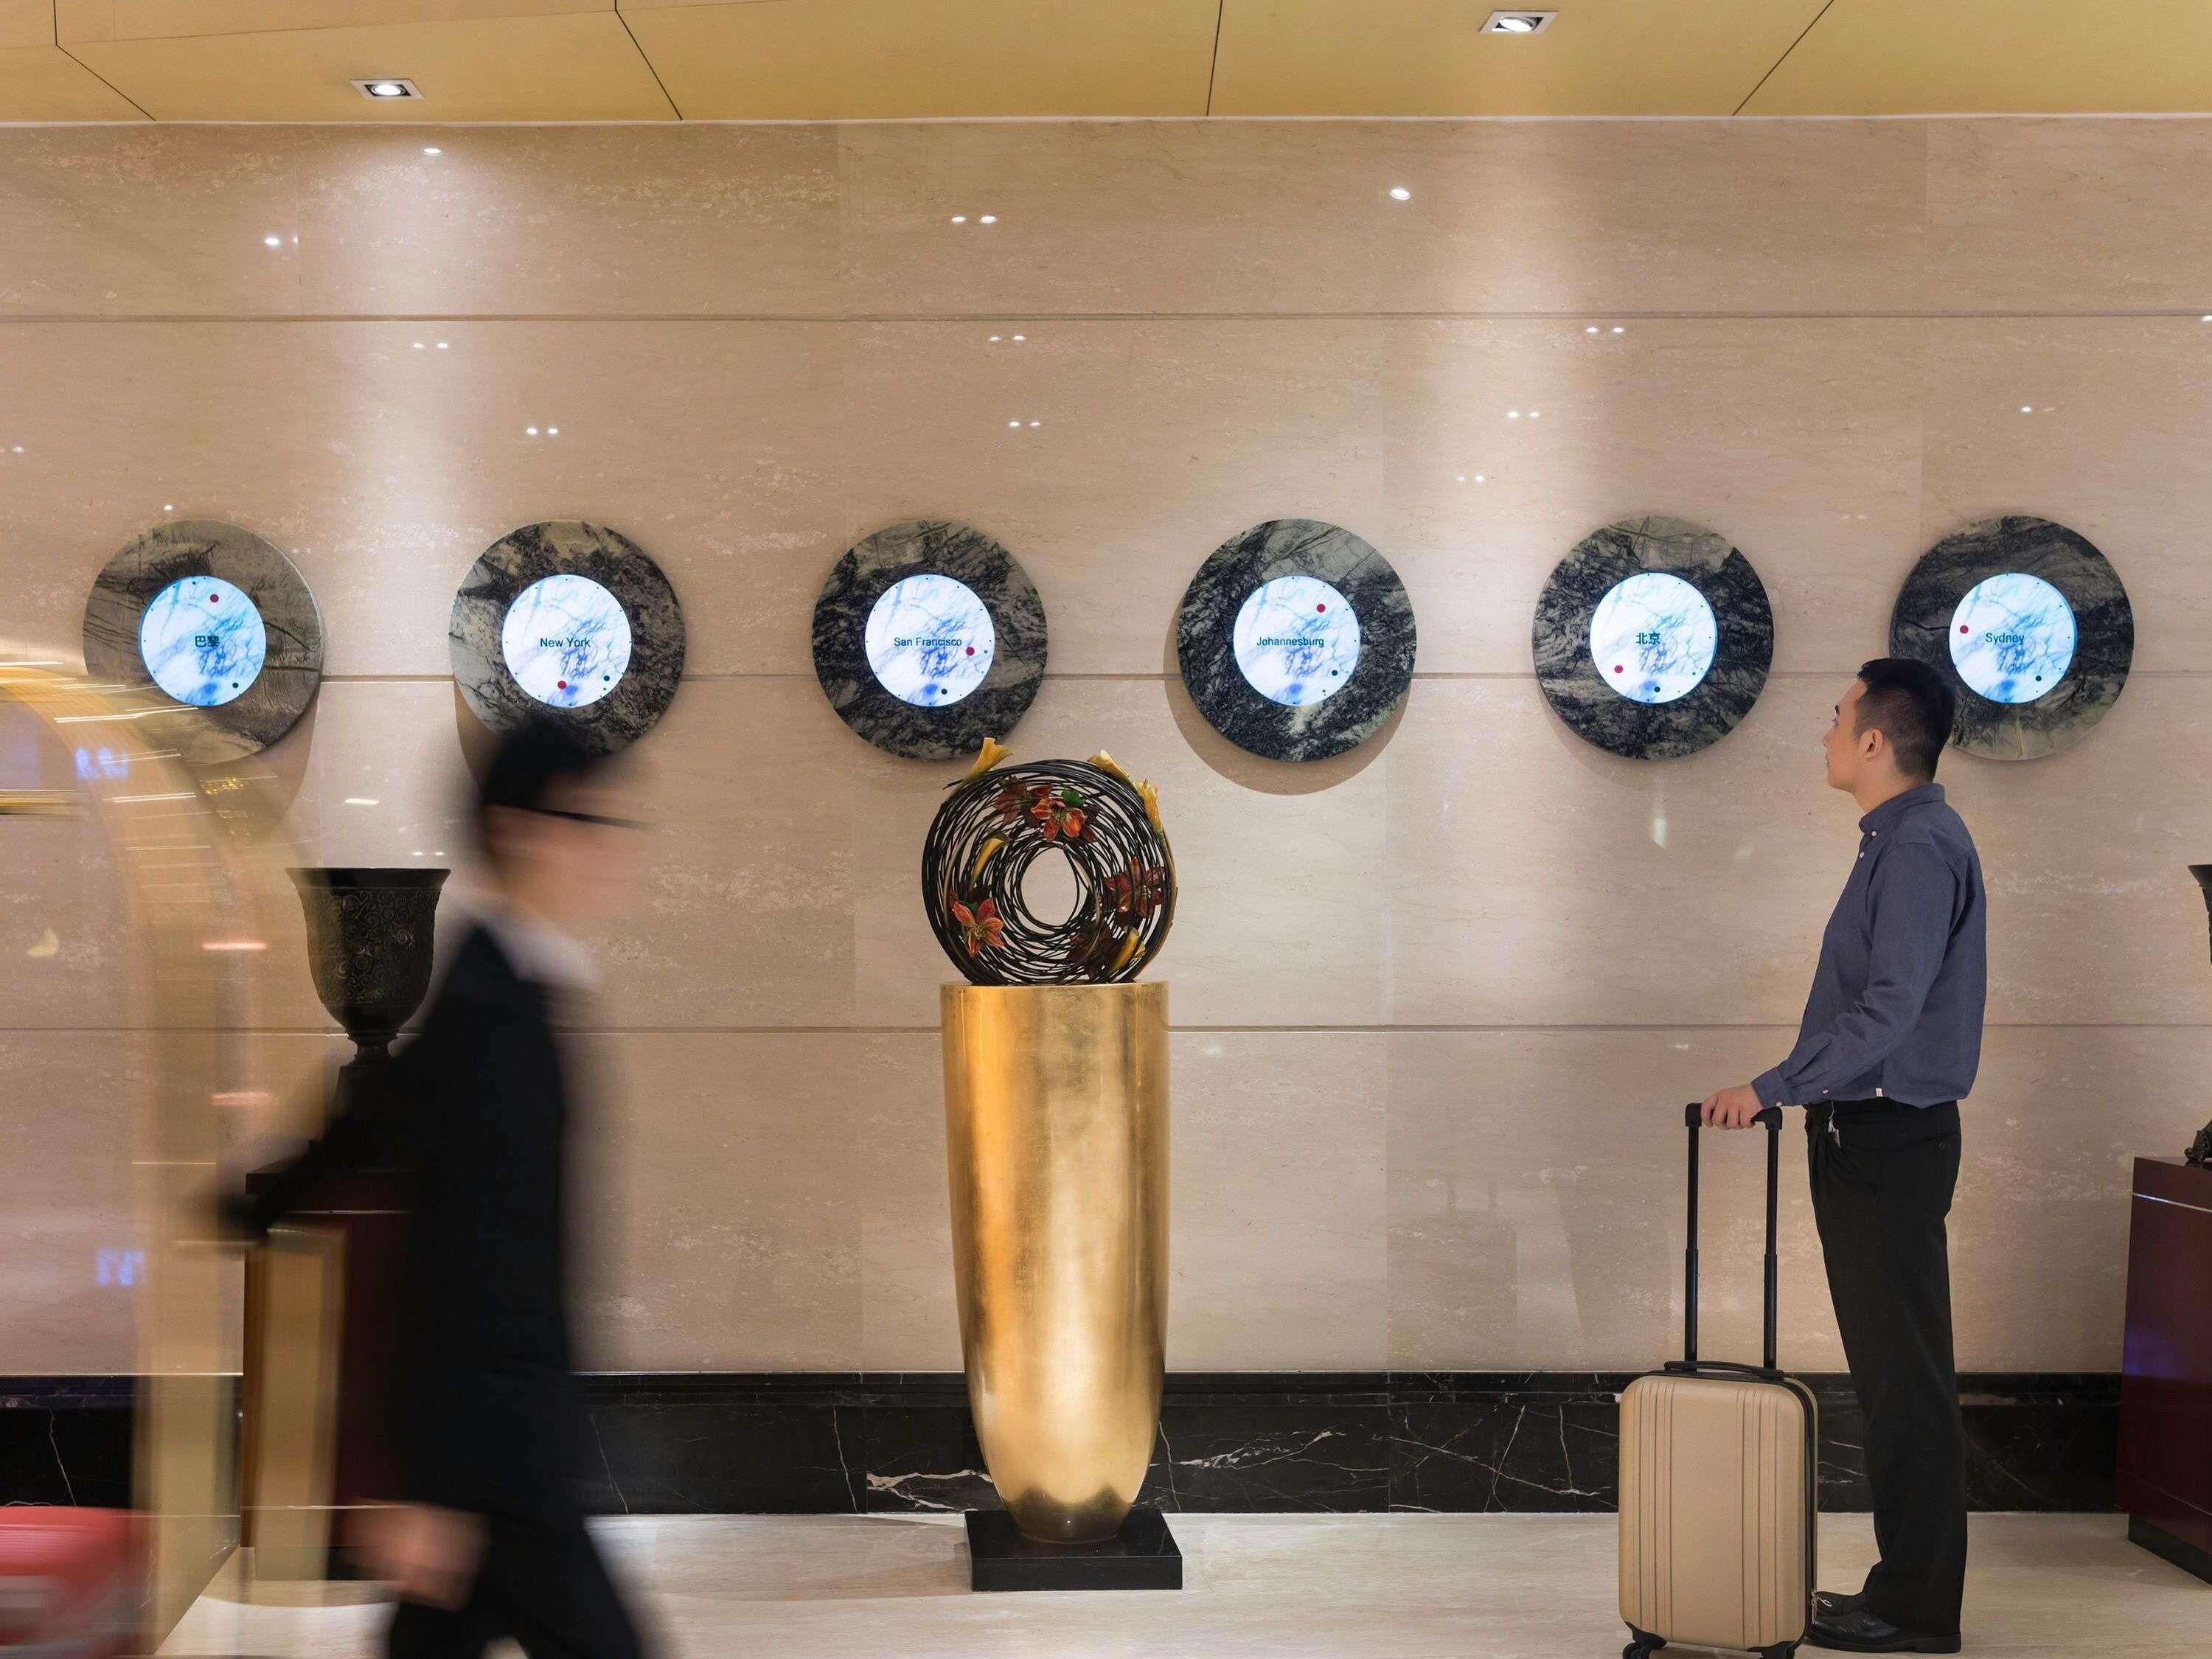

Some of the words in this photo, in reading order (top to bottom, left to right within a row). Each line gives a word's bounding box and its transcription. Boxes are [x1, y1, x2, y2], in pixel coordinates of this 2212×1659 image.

[195, 634, 220, 647] 巴黎
[540, 638, 563, 647] New
[566, 637, 591, 647] York
[894, 637, 913, 647] San
[916, 636, 962, 647] Francisco
[1256, 636, 1325, 648] Johannesburg
[1635, 631, 1660, 644] 北京
[1985, 632, 2025, 645] Sydney
